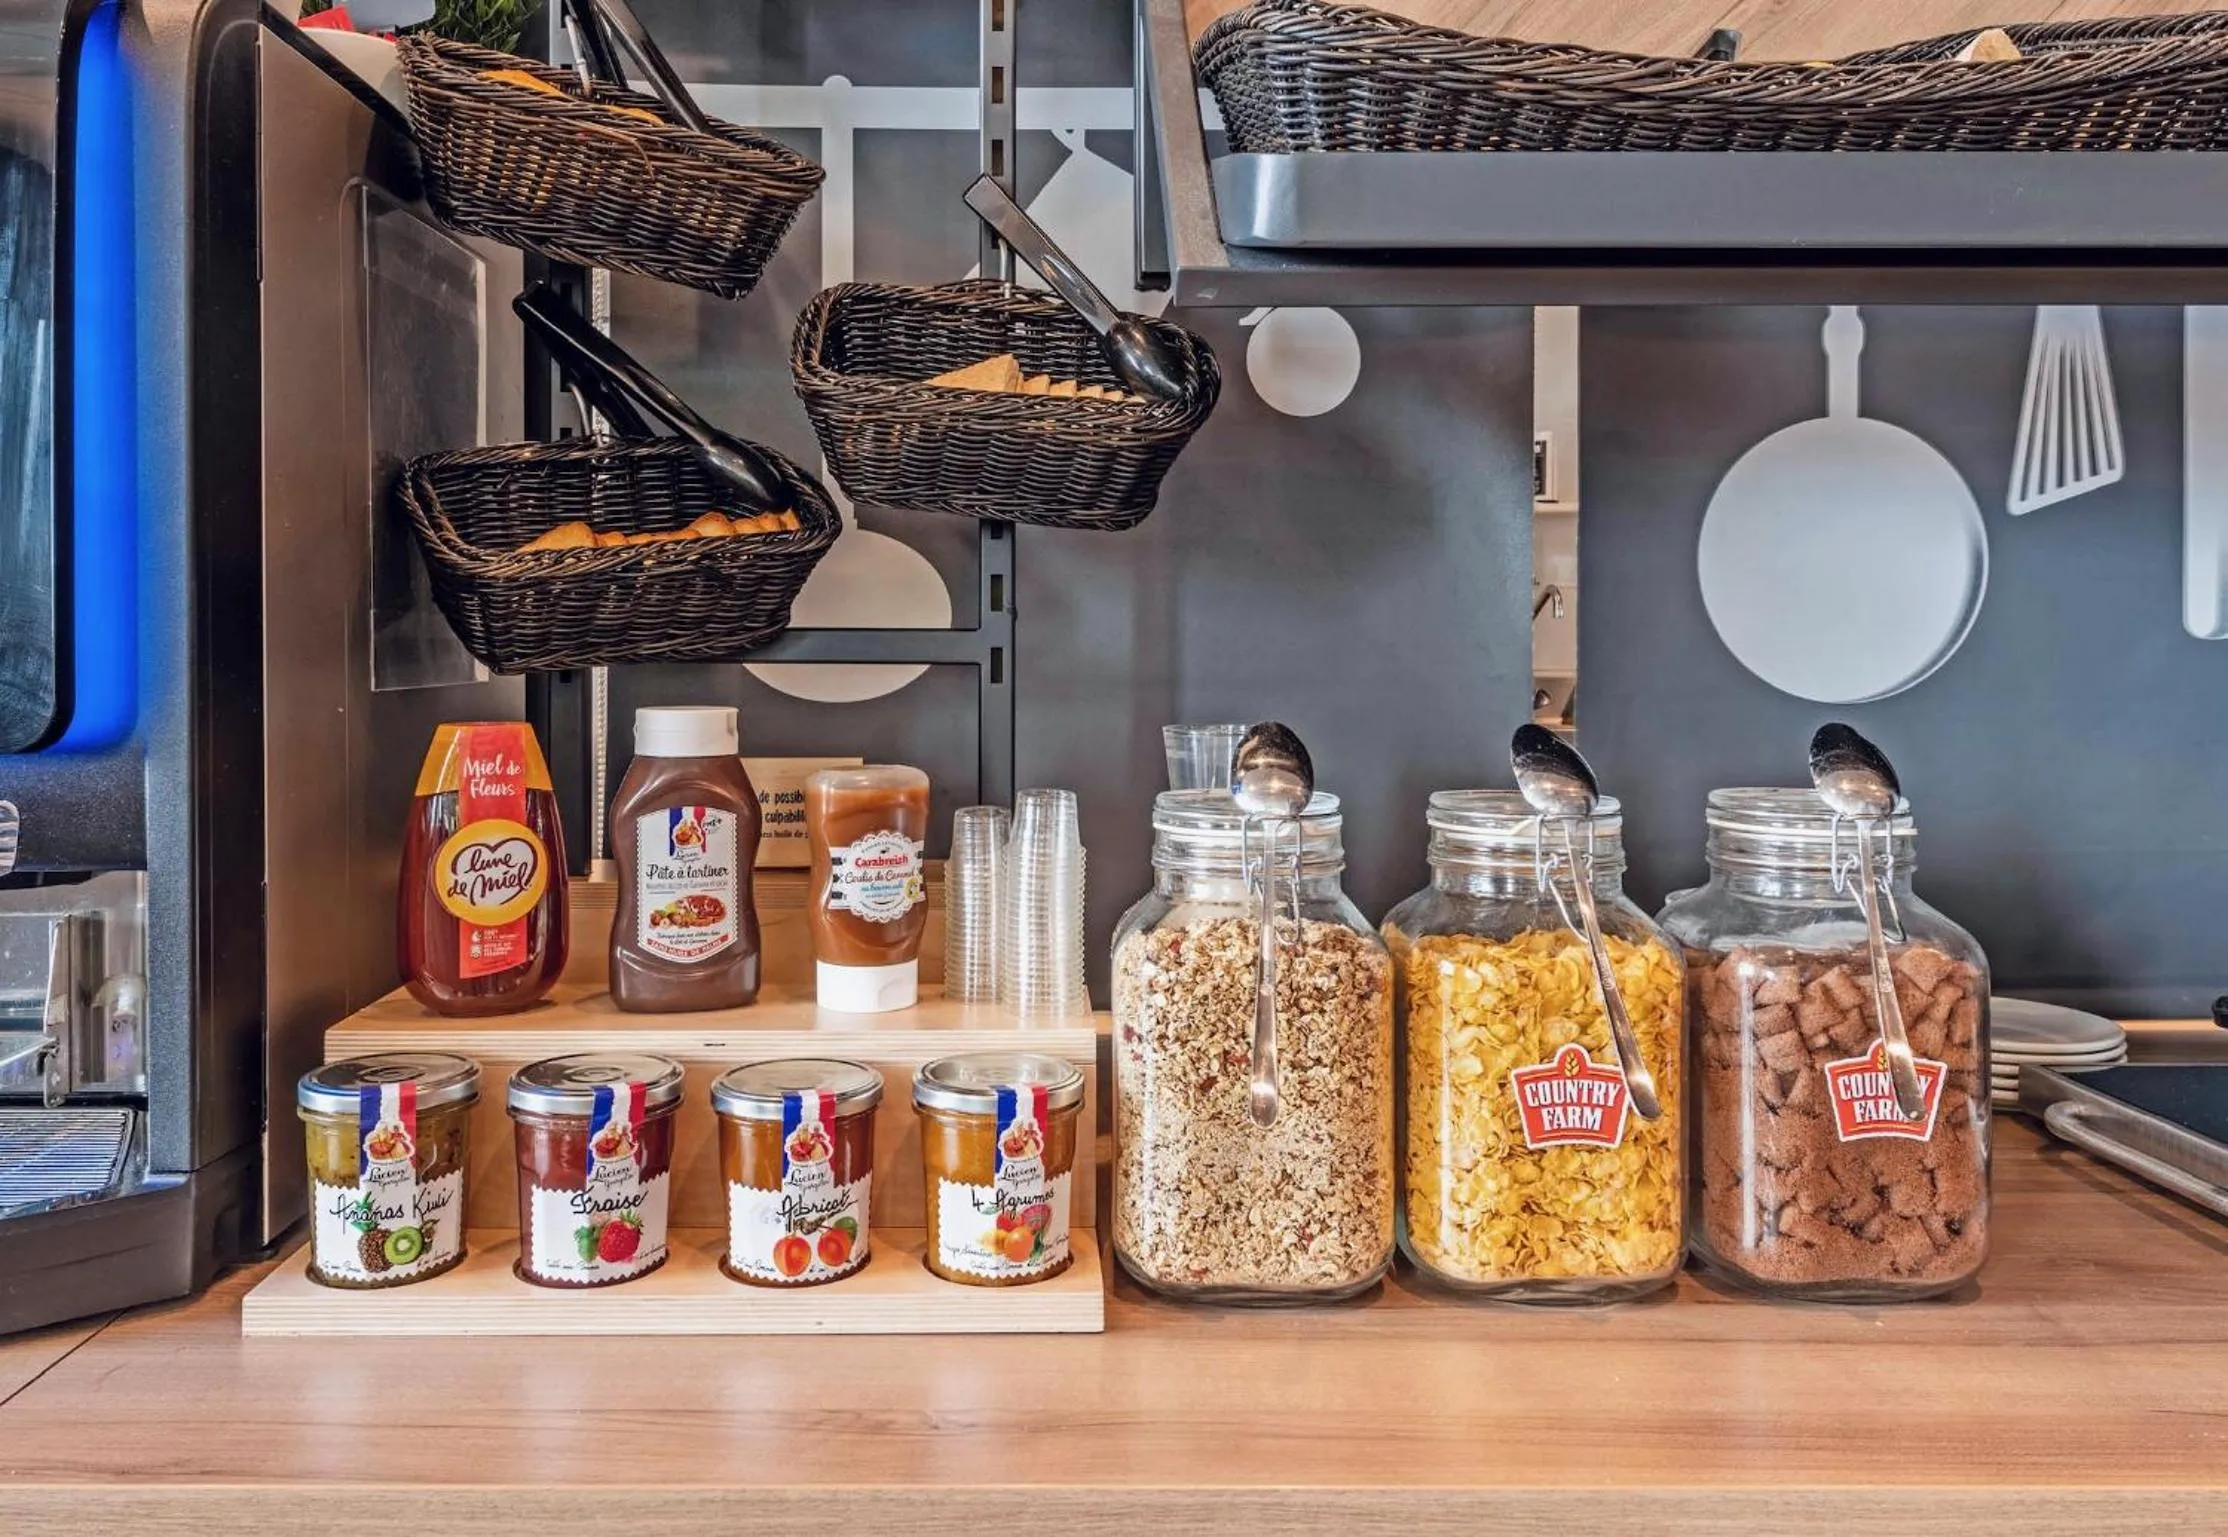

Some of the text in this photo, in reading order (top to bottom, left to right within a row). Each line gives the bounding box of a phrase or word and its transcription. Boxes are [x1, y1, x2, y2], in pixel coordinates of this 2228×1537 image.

[463, 753, 522, 778] Miel de
[470, 779, 517, 799] Fleurs
[687, 864, 729, 879] tartiner
[1524, 1079, 1621, 1107] COUNTRY
[1837, 1071, 1933, 1100] COUNY
[1541, 1106, 1604, 1131] FARM
[570, 1185, 649, 1215] Fraise
[776, 1188, 852, 1233] Abricot
[971, 1189, 984, 1211] 4
[329, 1193, 405, 1235] Ananas
